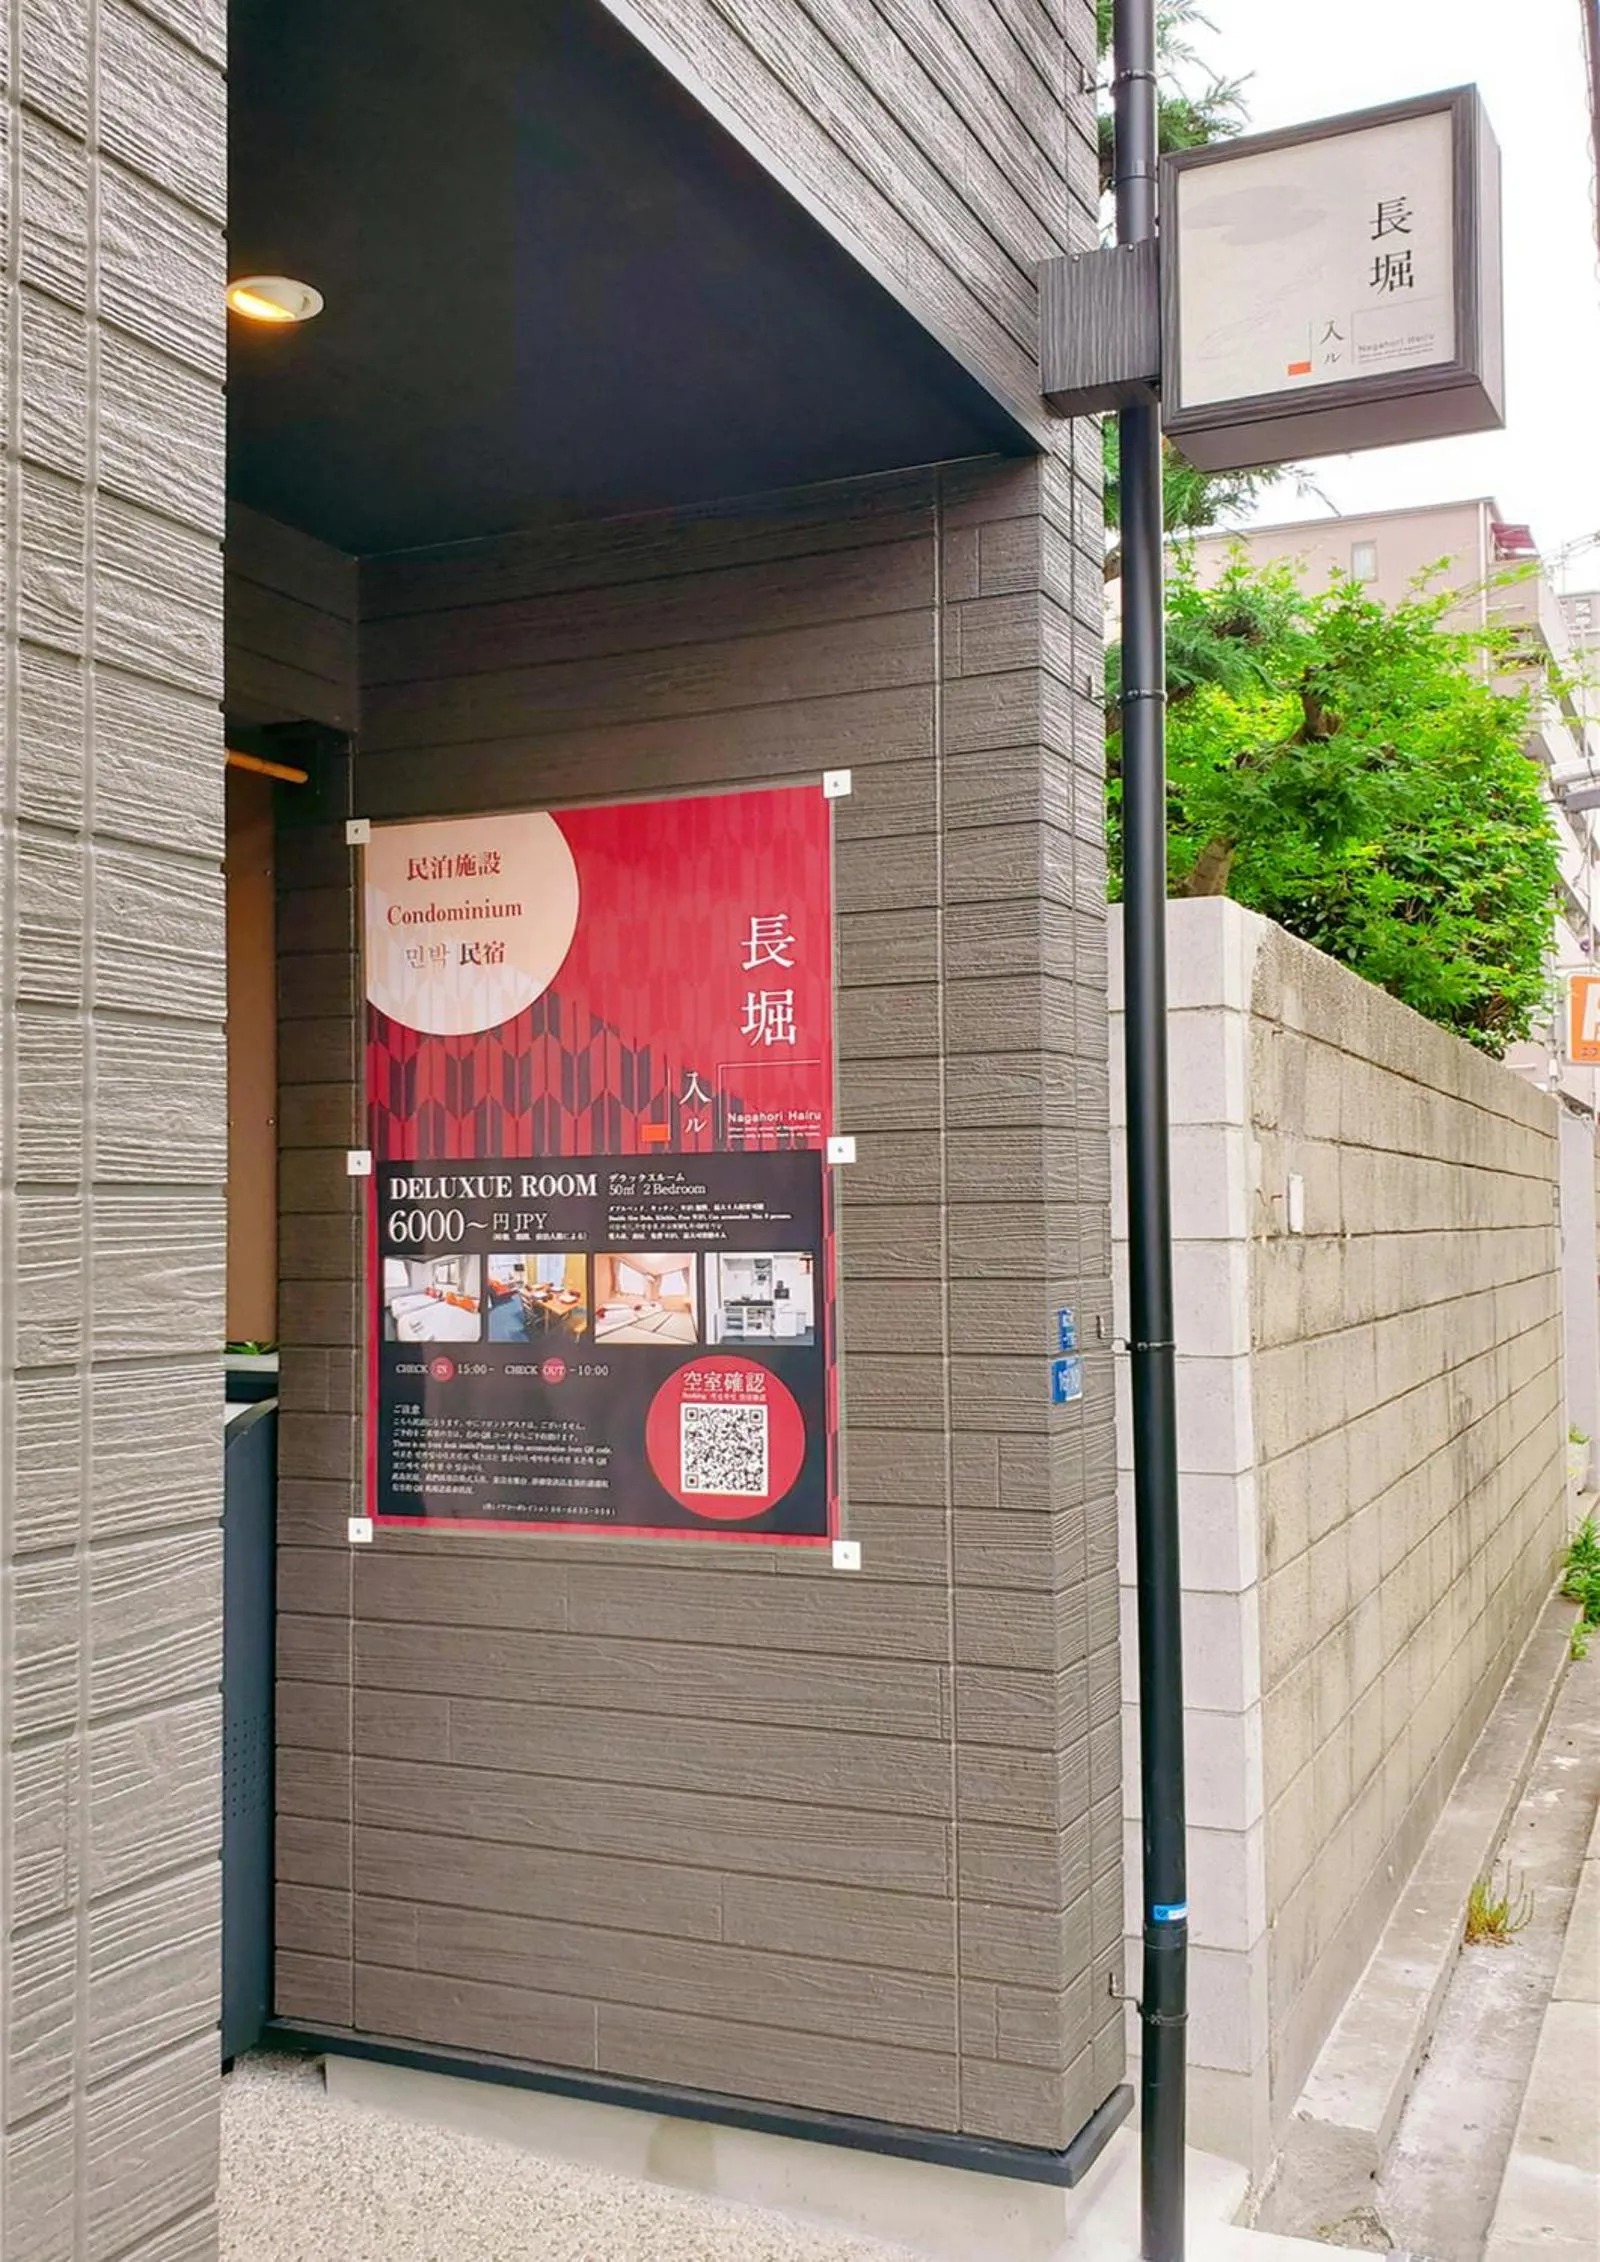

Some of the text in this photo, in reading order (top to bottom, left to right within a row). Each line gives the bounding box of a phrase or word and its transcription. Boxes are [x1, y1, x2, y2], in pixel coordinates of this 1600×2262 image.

[1368, 196, 1415, 296] 長堀
[1319, 319, 1346, 365] 入ル
[406, 851, 501, 881] 民泊施設
[387, 898, 523, 925] Condominium
[405, 941, 505, 969] 민박 民宿
[740, 913, 797, 1047] 長堀
[679, 1071, 713, 1134] 入ル
[727, 1110, 822, 1125] Nagahori Hairu
[389, 1174, 599, 1200] DELUXUE ROOM
[652, 1183, 707, 1195] Bedroom
[513, 1213, 548, 1232] JPY
[395, 1363, 430, 1374] CHECK
[504, 1364, 539, 1375] CHECK
[542, 1365, 566, 1376] OUT
[683, 1370, 767, 1393] 空室確認
